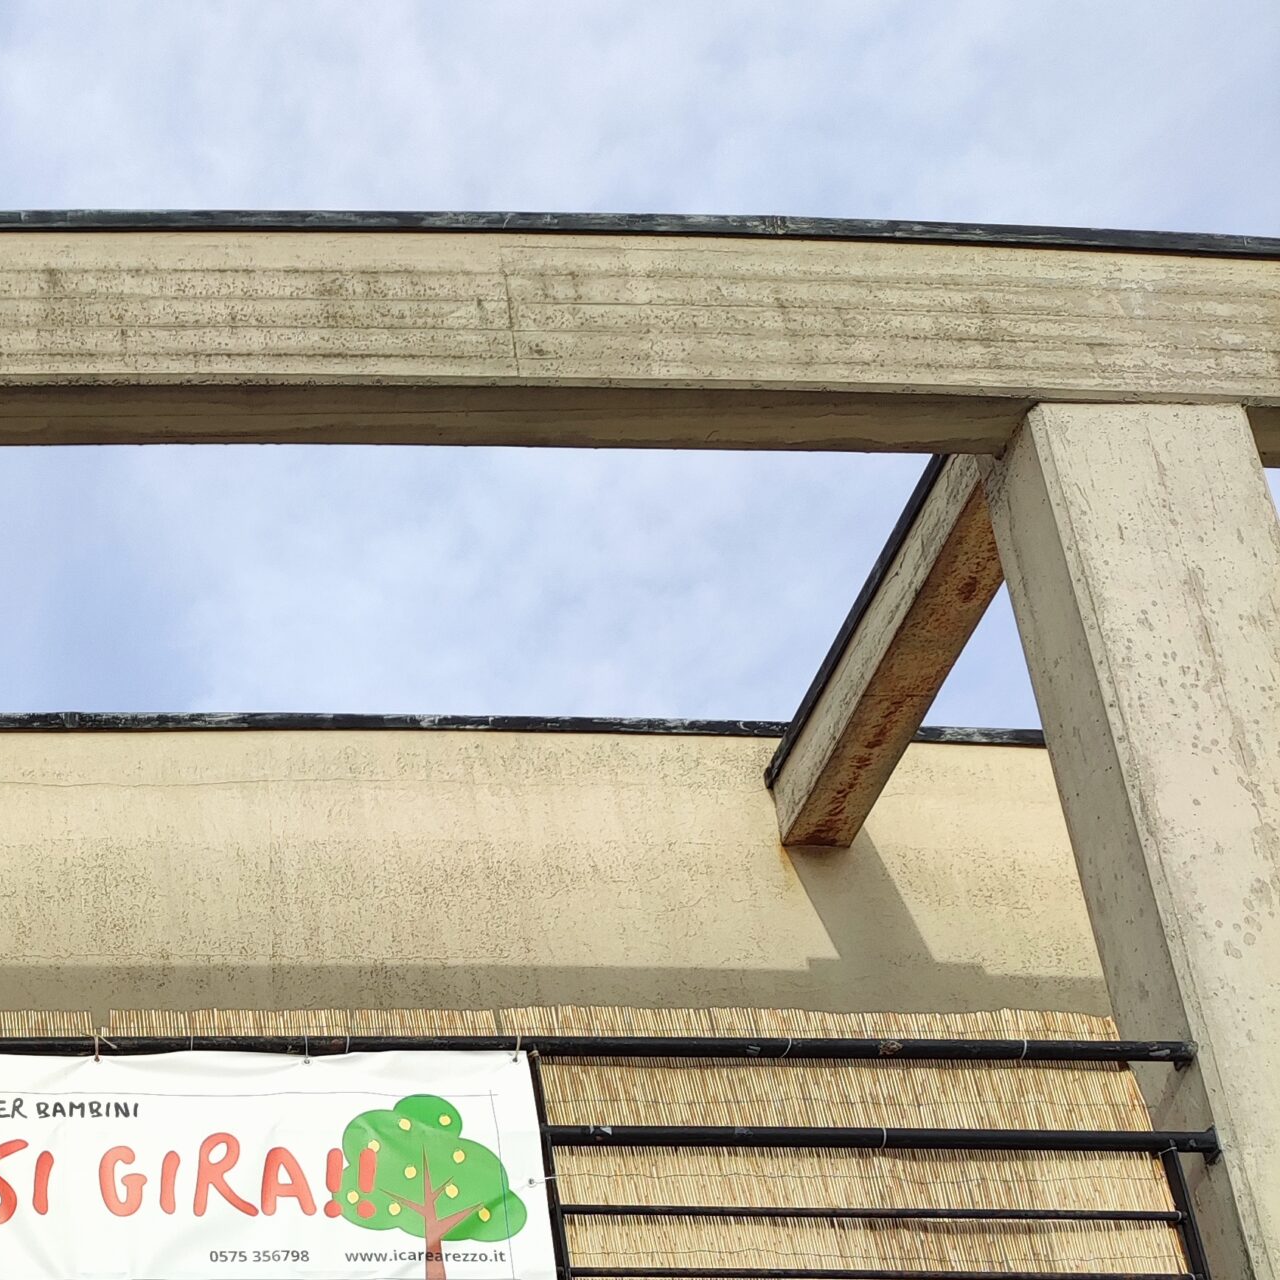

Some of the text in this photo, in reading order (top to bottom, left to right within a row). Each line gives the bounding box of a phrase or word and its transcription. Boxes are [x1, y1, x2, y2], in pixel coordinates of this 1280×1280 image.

[36, 1100, 140, 1119] BAMBINI
[209, 1248, 507, 1264] 0575 356798 www.icarearezzo.it
